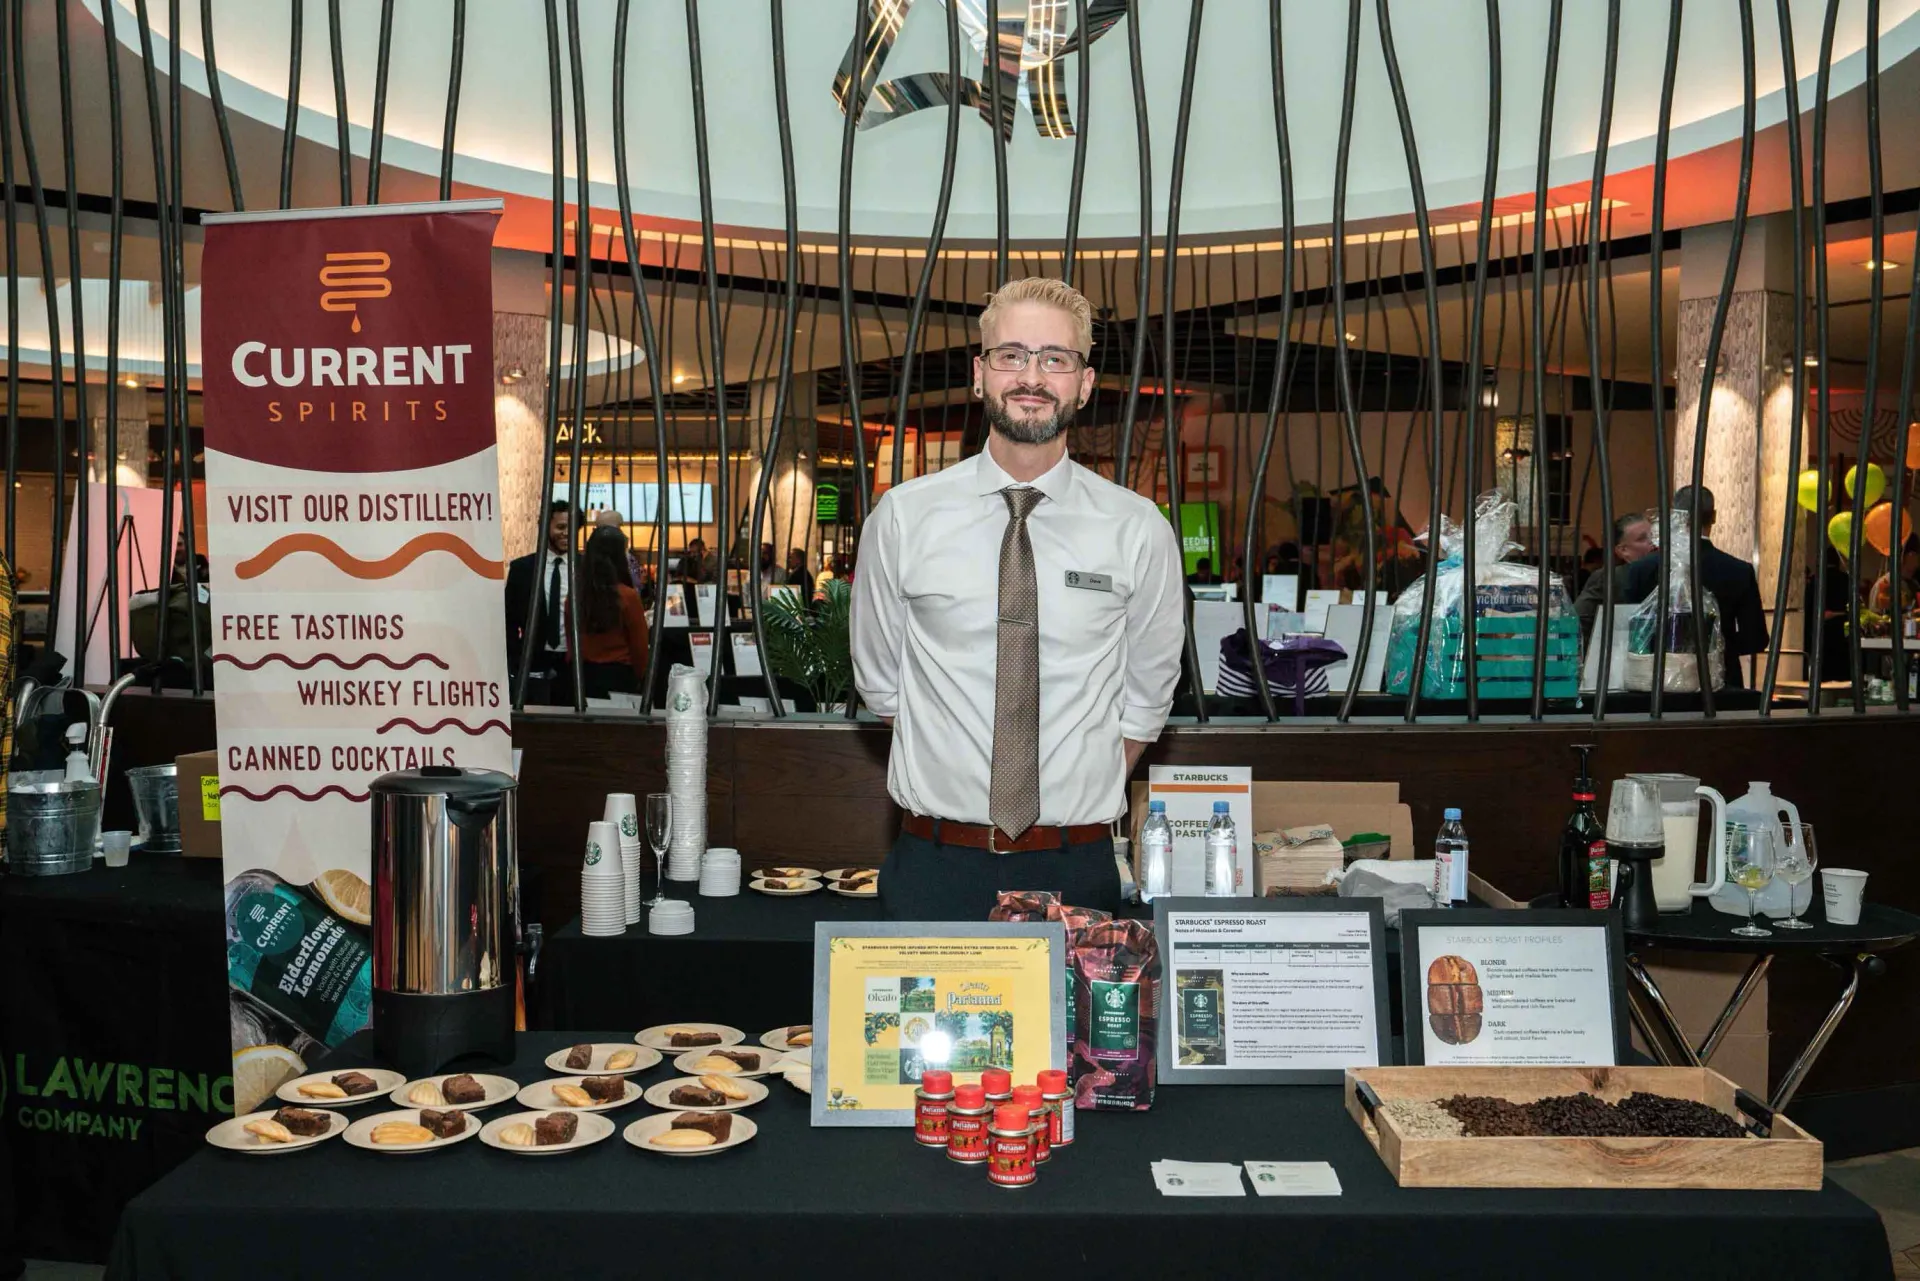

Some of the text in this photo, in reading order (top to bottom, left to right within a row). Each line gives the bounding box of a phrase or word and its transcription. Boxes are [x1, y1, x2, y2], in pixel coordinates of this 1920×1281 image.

[232, 341, 472, 387] CURRENT
[268, 401, 447, 422] SPIRITS
[228, 492, 492, 523] VISIT OUR DISTILLERY!
[1476, 594, 1509, 604] VICTORY
[222, 614, 404, 640] FREE TASTINGS
[297, 680, 500, 708] WHISKEY FLIGHTS
[228, 746, 456, 771] CANNED COCKTAILS
[1168, 820, 1209, 828] COFFEE
[256, 903, 291, 947] CURRENT
[1446, 936, 1563, 944] STARBUCKS ROAST PROFILES
[278, 916, 336, 996] Elderflower
[293, 926, 346, 998] Lemonade
[18, 1106, 142, 1140] COMPANY
